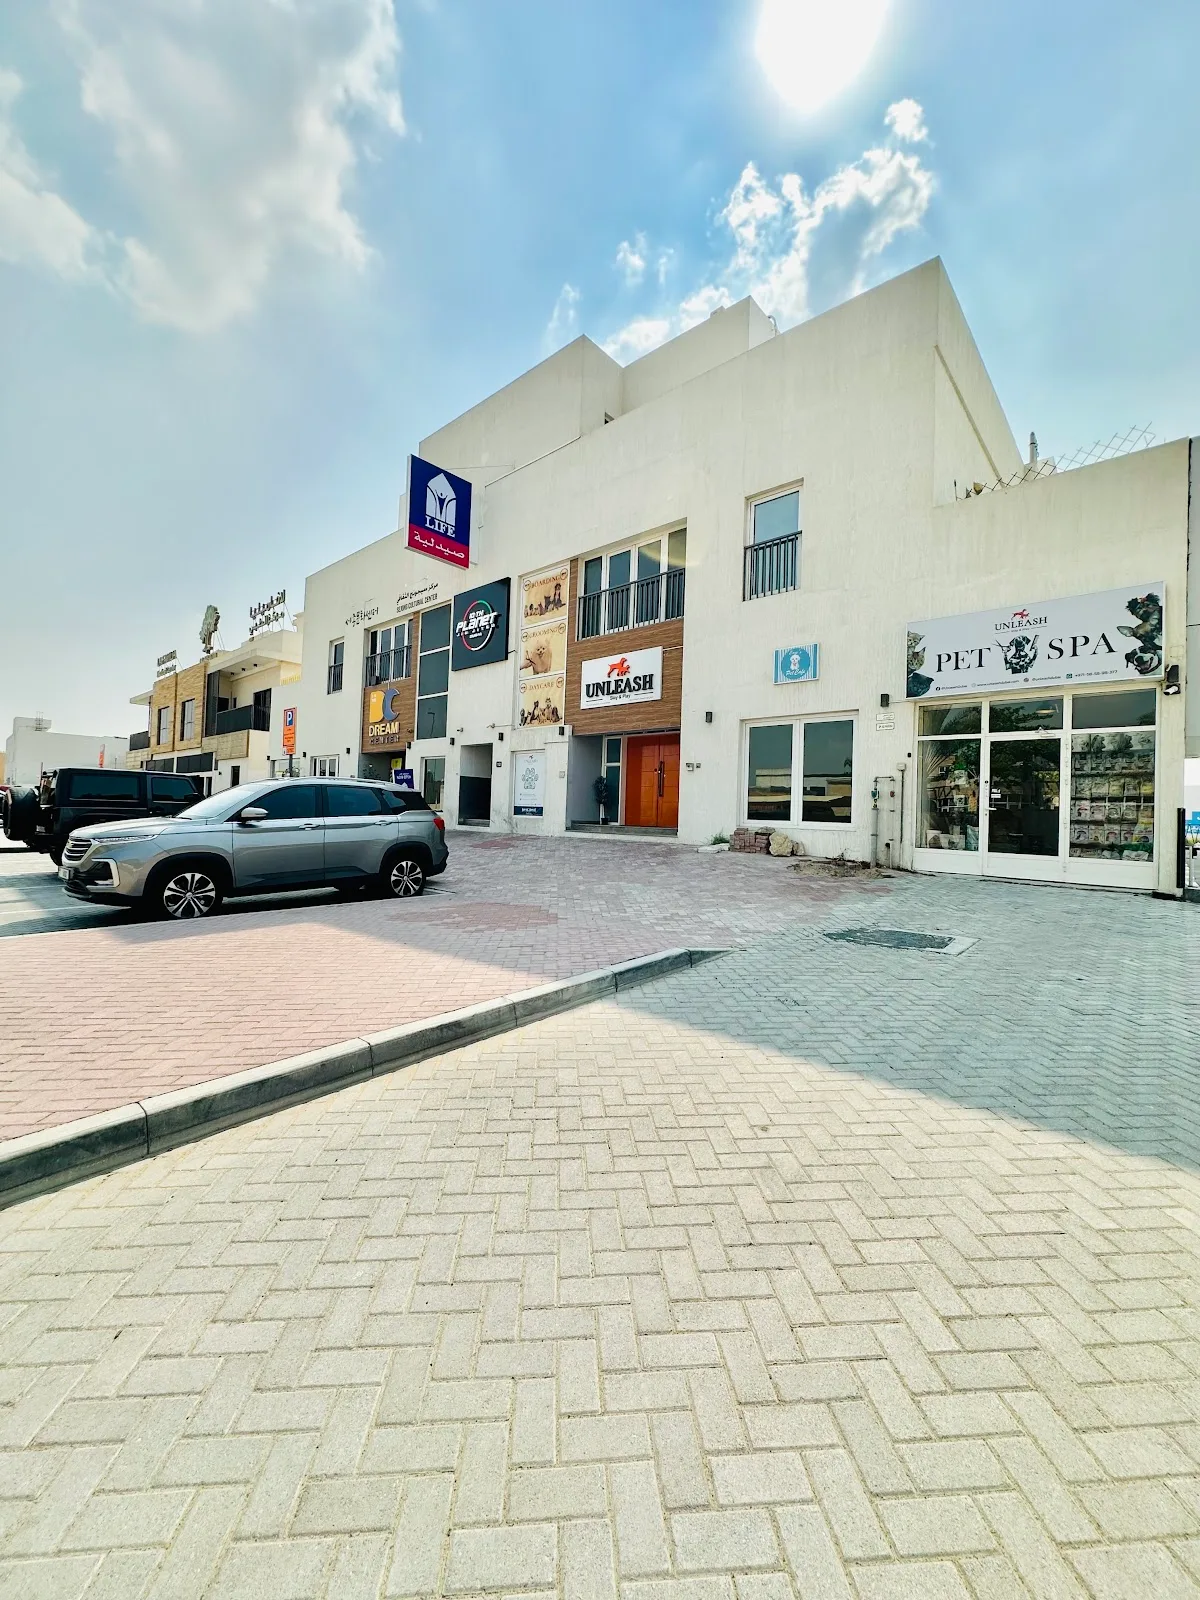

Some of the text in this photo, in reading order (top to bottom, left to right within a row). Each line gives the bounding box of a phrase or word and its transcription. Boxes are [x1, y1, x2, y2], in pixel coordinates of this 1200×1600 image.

[425, 515, 455, 537] LIFE
[414, 530, 465, 559] صيدلية
[531, 576, 560, 588] BOARDING
[408, 597, 424, 610] CULTURAL
[424, 593, 438, 604] CENTER
[529, 625, 559, 638] GROOMING
[995, 616, 1047, 631] UNLEASH
[936, 632, 1119, 673] PET SPA
[529, 682, 554, 690] DAYCARE
[585, 674, 654, 698] UNLEASH
[369, 721, 400, 737] DREAM
[370, 734, 399, 745] CENTER
